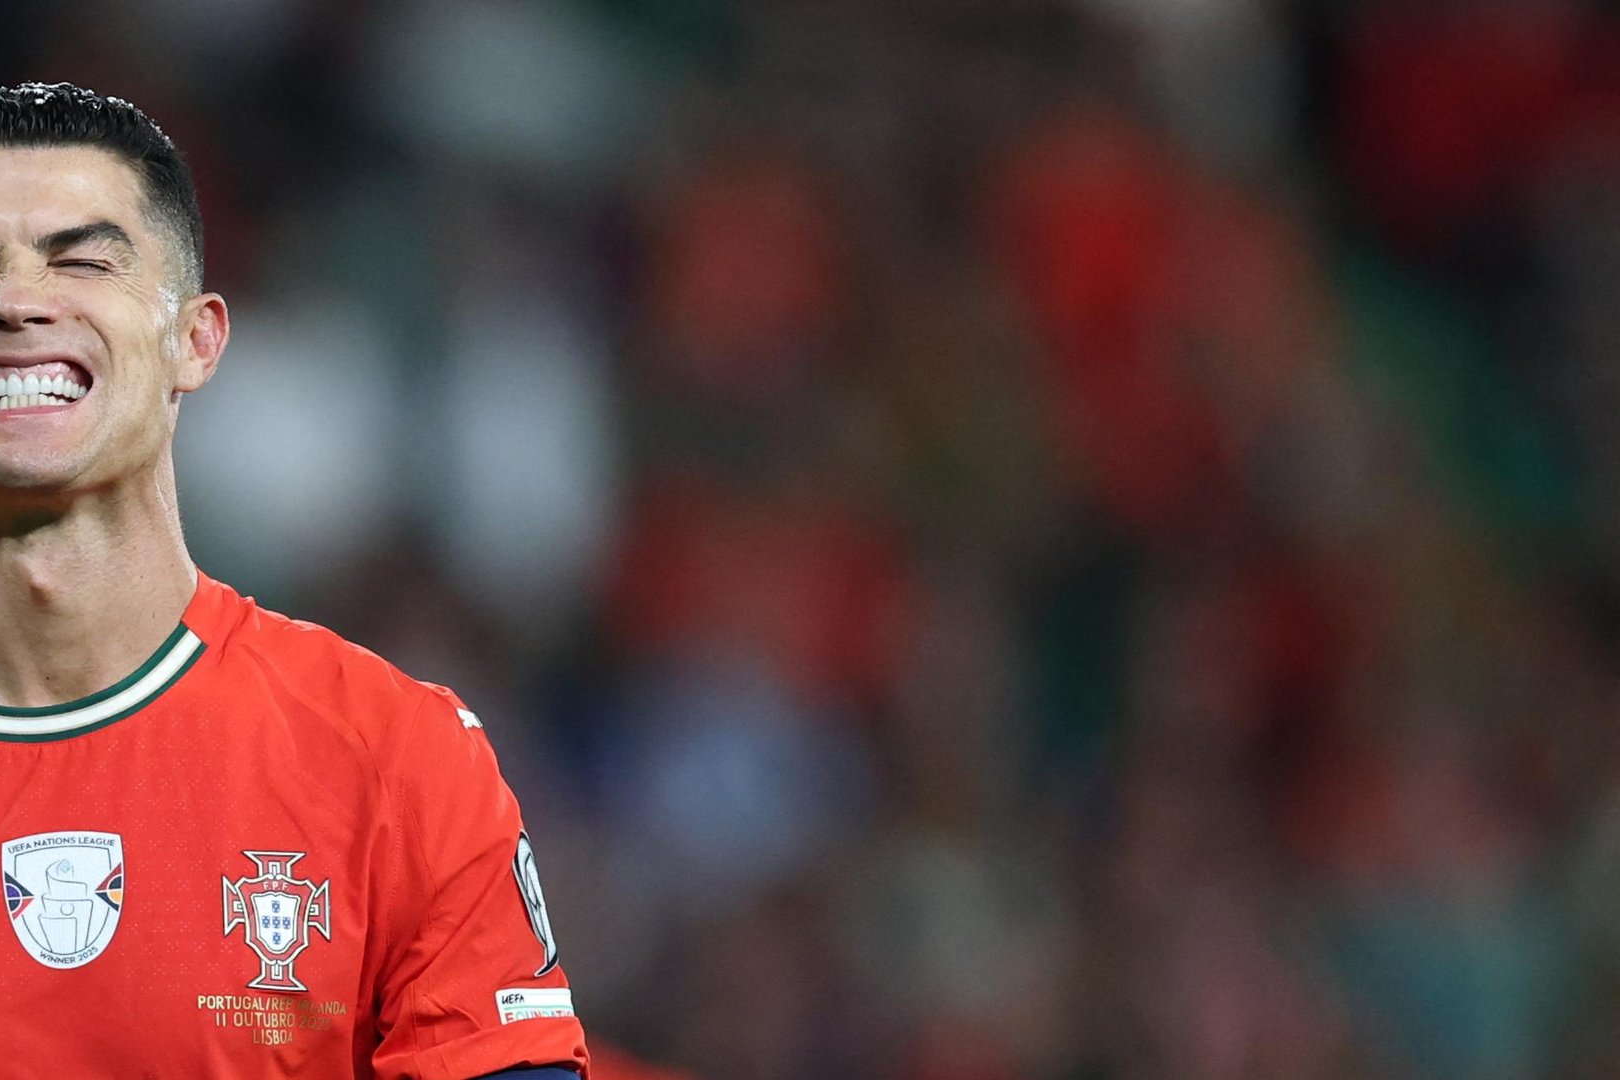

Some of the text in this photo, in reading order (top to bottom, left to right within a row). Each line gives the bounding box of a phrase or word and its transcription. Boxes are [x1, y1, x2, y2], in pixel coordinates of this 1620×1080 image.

[8, 837, 115, 854] UEFA NATIONS LEAGUE
[40, 946, 98, 964] WINNER 2025
[502, 993, 525, 1005] UEFA
[216, 1012, 226, 1027] 11
[233, 1011, 295, 1027] OUTUBRO
[253, 1029, 293, 1045] LISBOA
